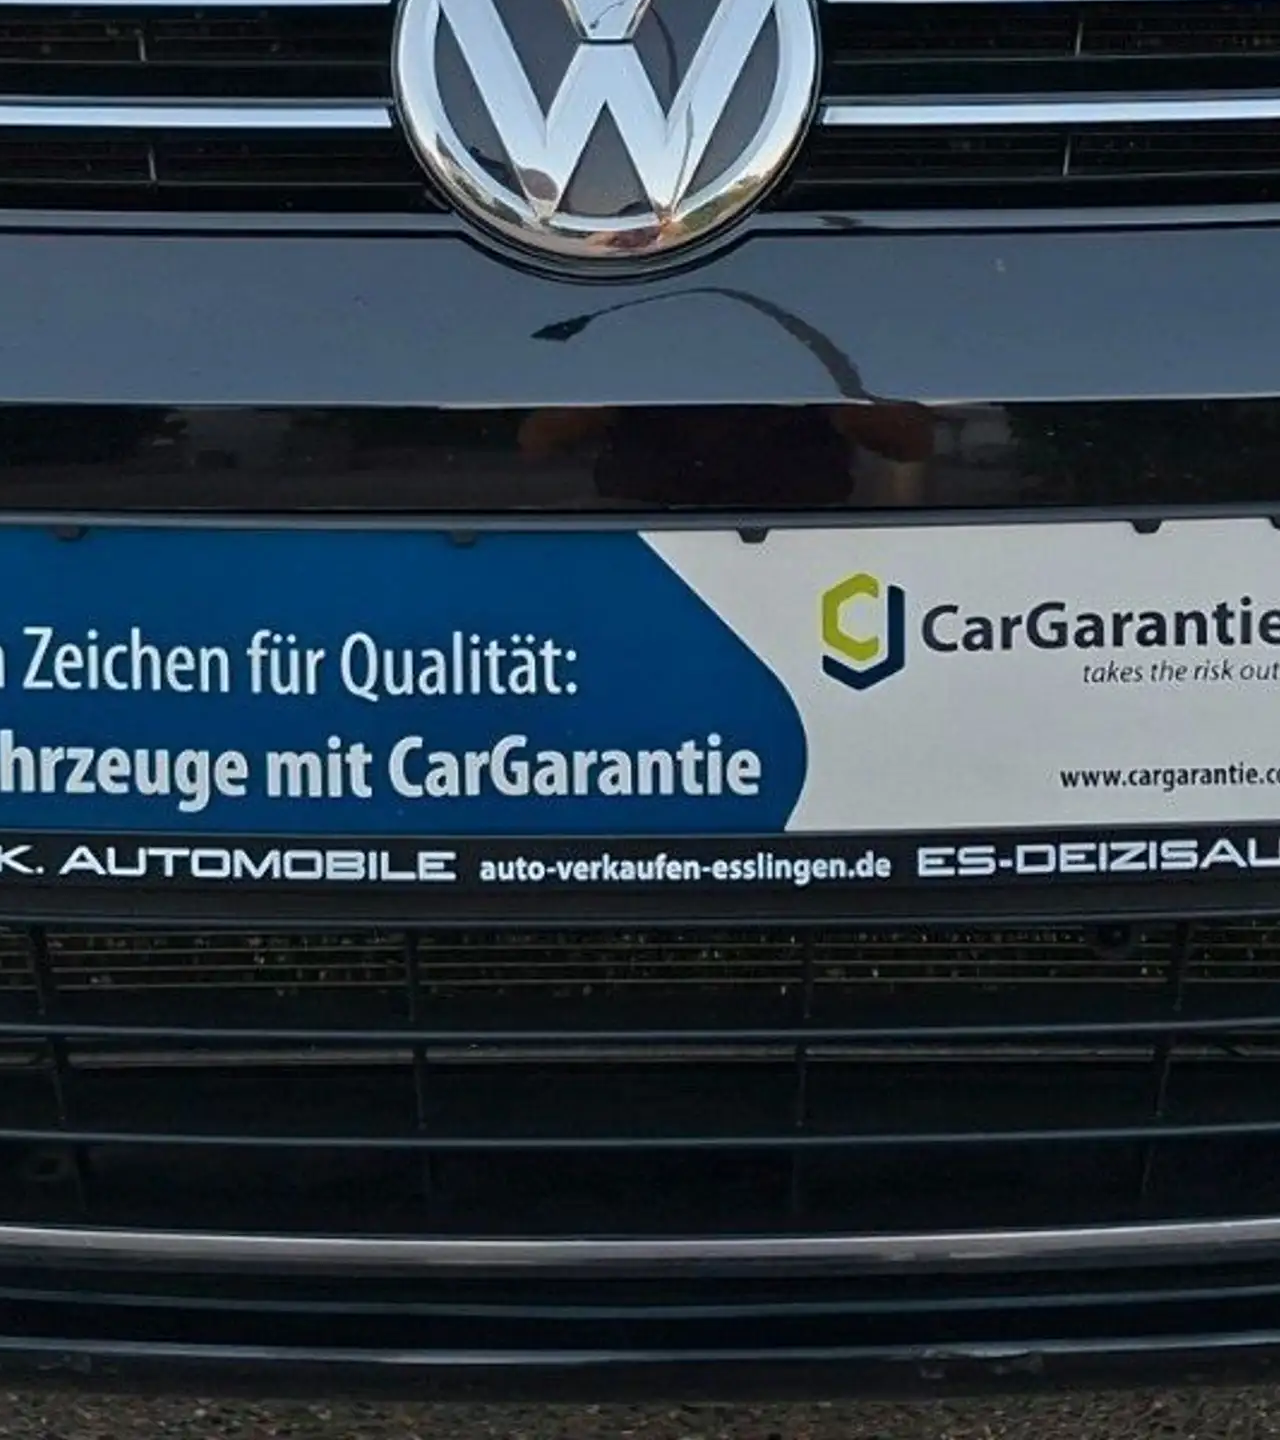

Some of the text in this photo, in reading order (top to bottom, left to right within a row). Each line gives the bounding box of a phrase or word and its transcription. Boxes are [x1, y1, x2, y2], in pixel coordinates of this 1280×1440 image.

[22, 625, 230, 693] Zeichen
[246, 629, 326, 695] für
[340, 630, 578, 702] Qualität:
[1082, 658, 1280, 685] takes the risk out
[265, 735, 373, 798] mit
[388, 732, 763, 798] CarGarantie
[58, 845, 458, 881] AUTOMOBILE
[479, 850, 893, 886] auto-verkaufen-esslingen.de
